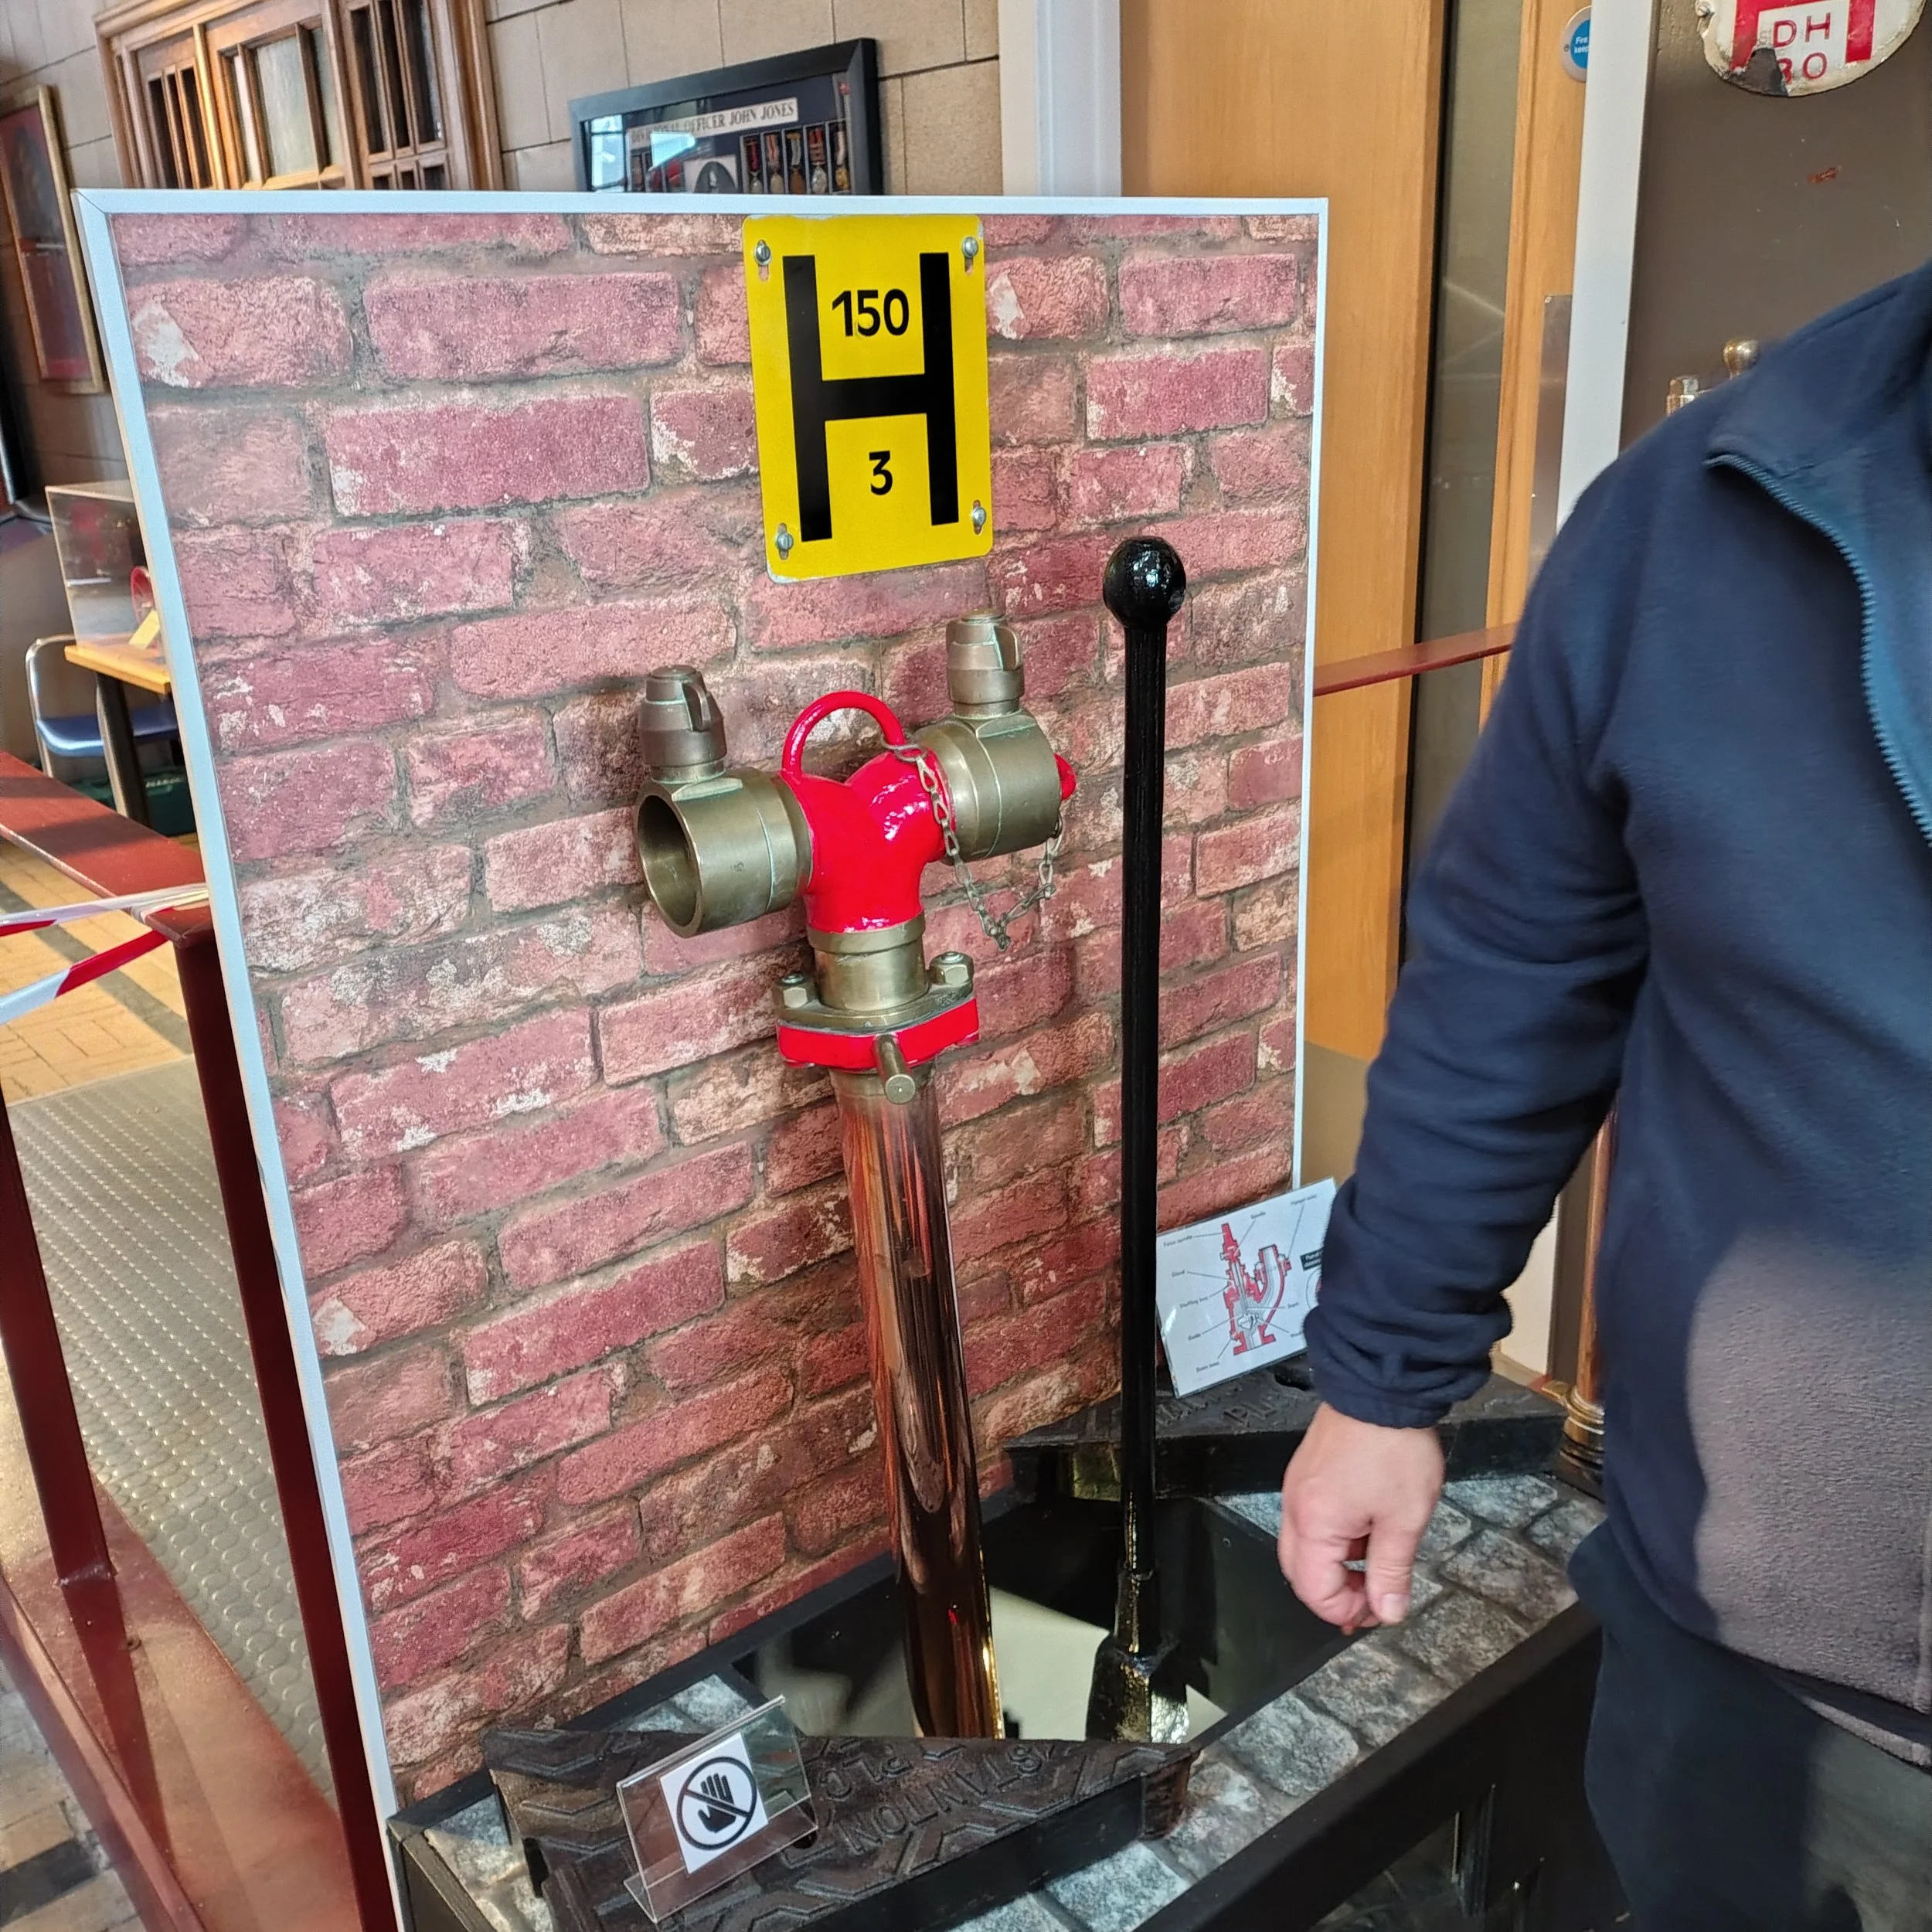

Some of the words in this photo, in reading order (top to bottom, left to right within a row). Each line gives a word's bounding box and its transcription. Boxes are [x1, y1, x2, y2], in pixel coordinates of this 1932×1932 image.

[1772, 12, 1832, 48] DH
[729, 108, 757, 125] JOHN
[760, 101, 794, 121] JONES
[832, 288, 910, 337] 150
[869, 450, 893, 495] 3
